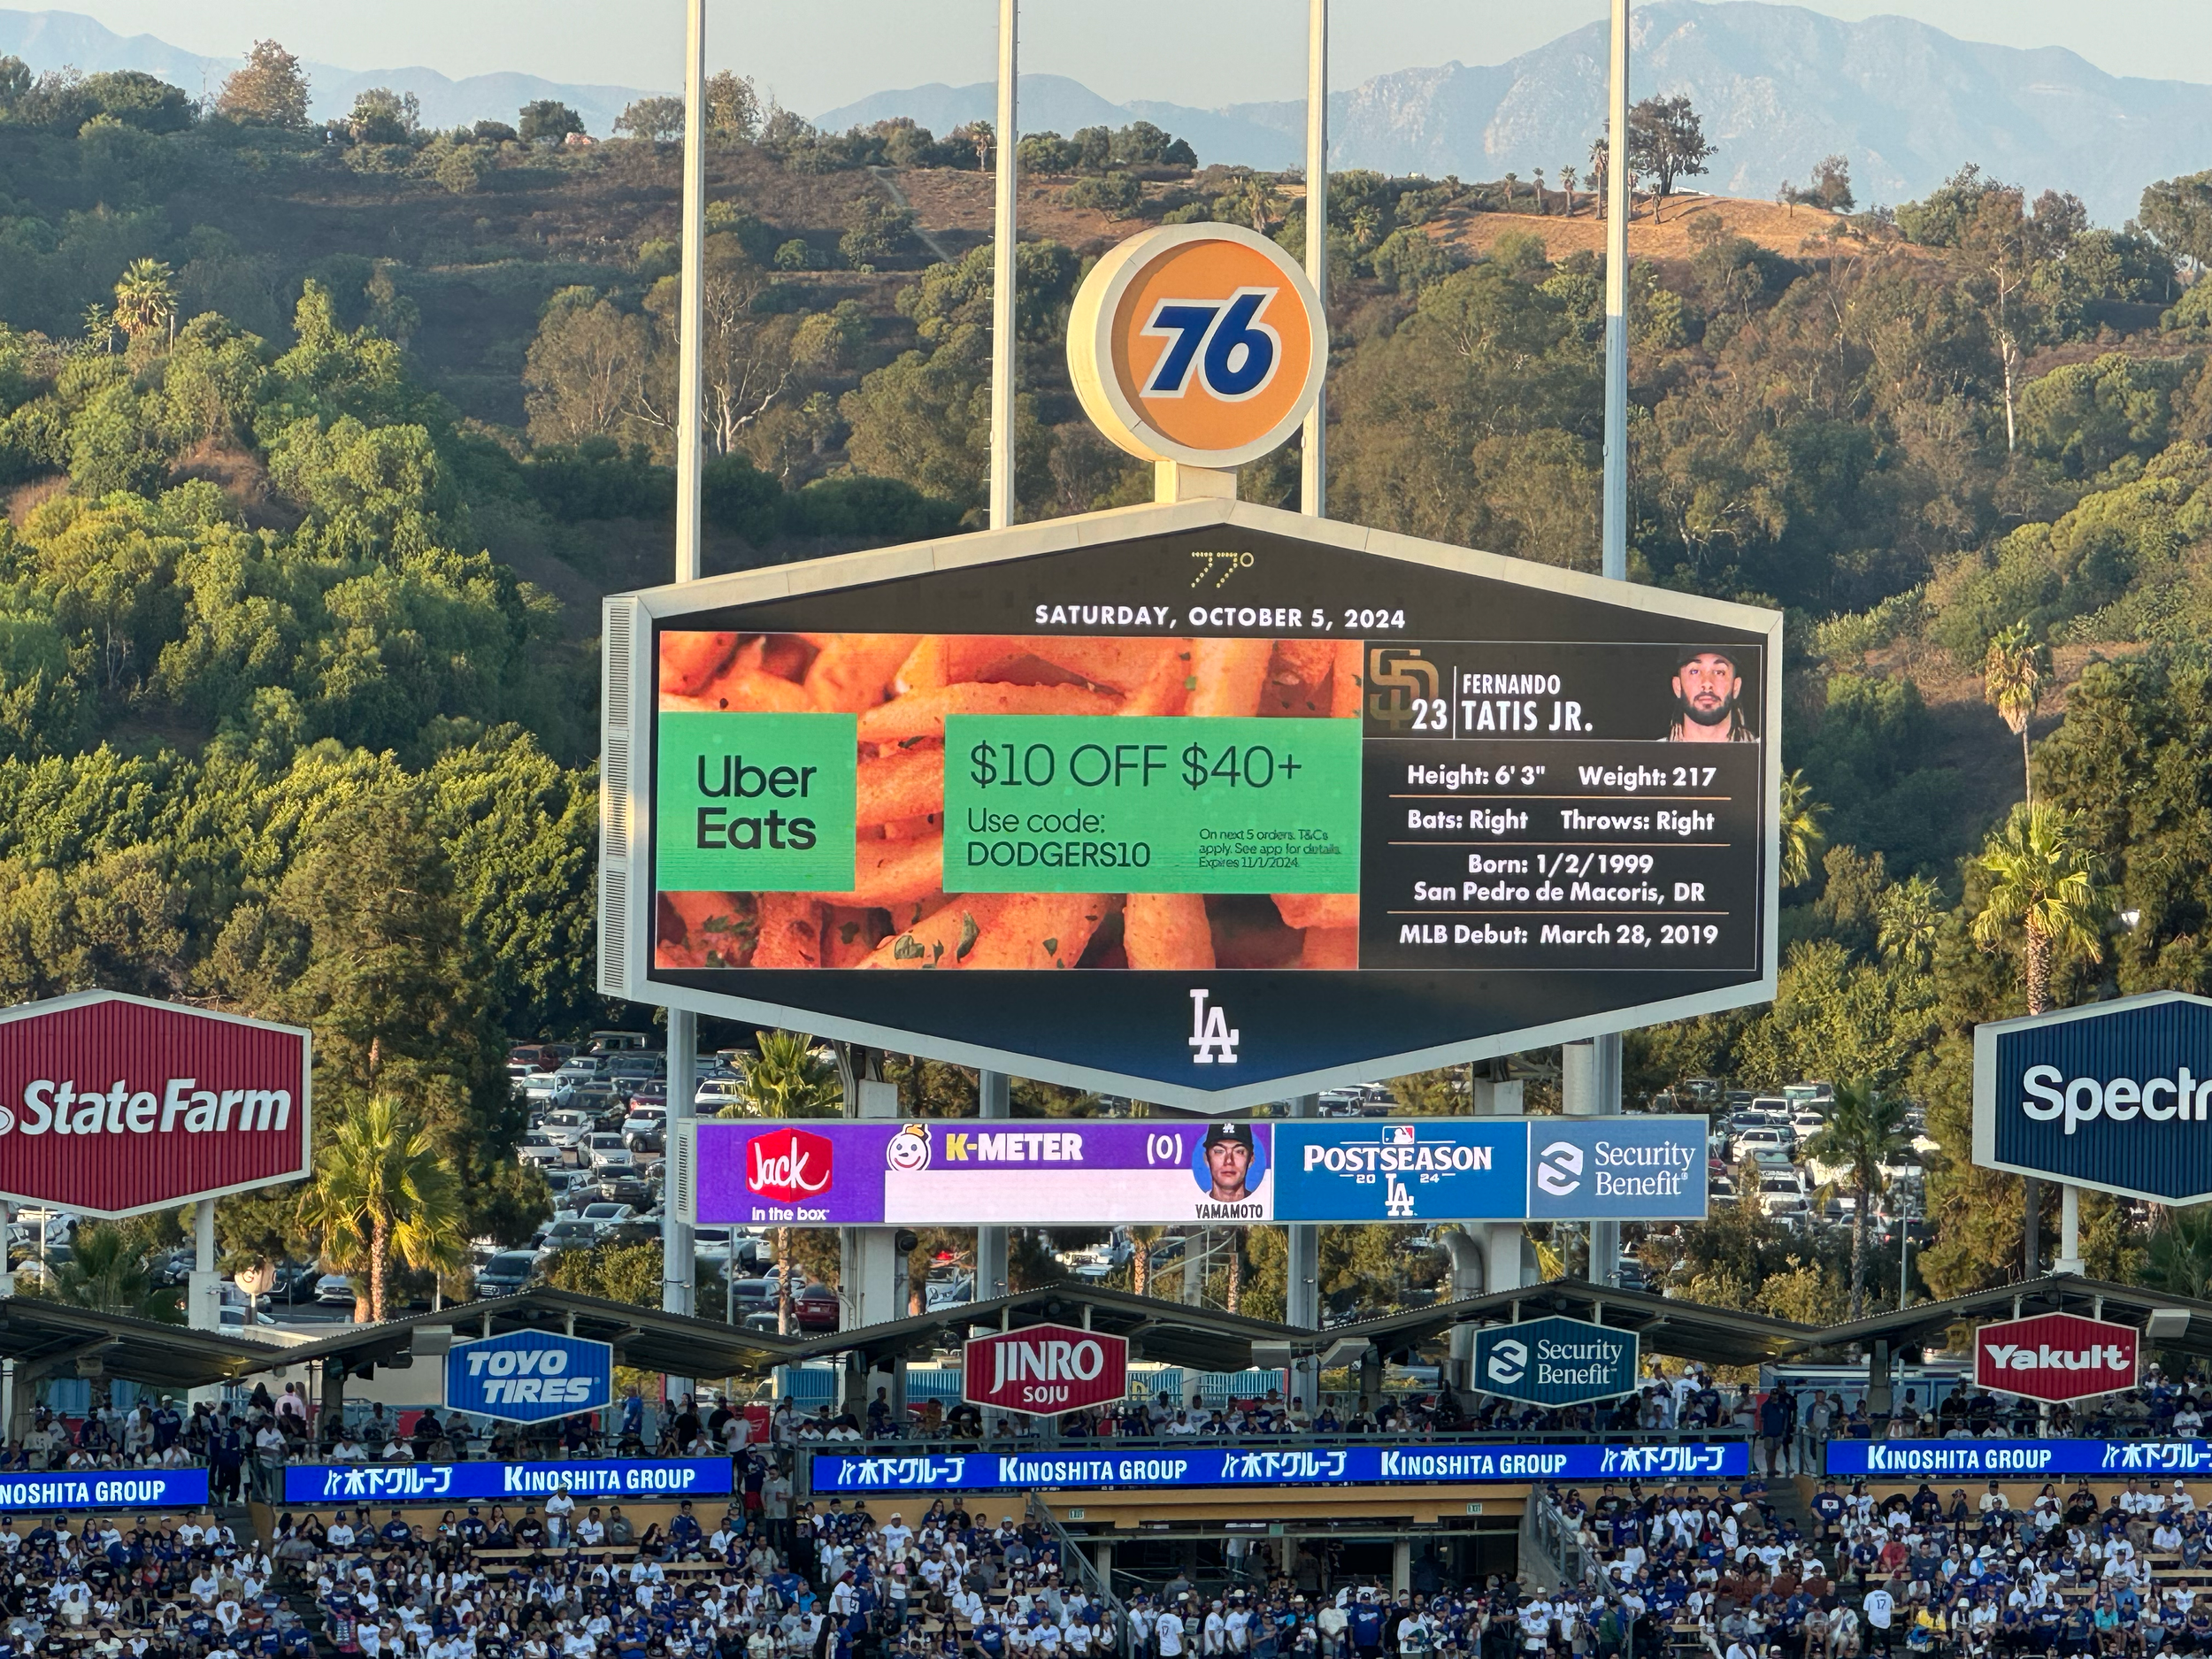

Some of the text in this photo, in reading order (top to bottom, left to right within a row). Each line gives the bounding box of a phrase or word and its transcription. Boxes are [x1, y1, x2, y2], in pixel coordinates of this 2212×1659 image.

[1140, 287, 1281, 402] 76
[1035, 604, 1405, 631] SATURDAY, OCTOBER 5, 2024
[1463, 673, 1561, 695] FERNANDO
[1411, 698, 1448, 730] 23
[1462, 700, 1594, 732] TATIS JR.
[696, 755, 817, 799] Uber
[970, 740, 1302, 791] $10 OFF $40+
[1408, 765, 1546, 790] Height: 6' 3"
[1578, 765, 1717, 791] Weight: 217
[695, 807, 817, 850] Eats
[967, 808, 1106, 833] Use code:
[1408, 808, 1529, 834] Bats: Right
[1561, 809, 1715, 835] Throws: Right
[1199, 828, 1217, 841] On
[1219, 829, 1245, 840] next
[1246, 829, 1255, 840] 5
[1298, 828, 1329, 841] T&Cs
[967, 841, 1150, 867] DODGERS10
[1198, 843, 1233, 856] apply.
[1234, 842, 1257, 854] See
[1259, 845, 1283, 856] app
[1286, 843, 1302, 855] for
[1198, 856, 1240, 871] Expires
[1468, 854, 1654, 878] Born: 1/2/1999
[1414, 881, 1706, 905] San Pedro de Macoris, DR
[1399, 925, 1718, 947] MLB Debut: March 28, 2019
[1188, 988, 1239, 1064] LA
[946, 1133, 1083, 1162] K-METER
[1147, 1133, 1183, 1164] (0)
[1303, 1144, 1493, 1171] POSTSEASON
[1594, 1141, 1696, 1171] Security
[749, 1136, 830, 1192] Jack
[1356, 1173, 1440, 1184] 20 24
[1385, 1173, 1415, 1217] LA
[768, 1206, 794, 1220] the
[797, 1206, 827, 1220] box
[1194, 1203, 1263, 1219] YAMAMOTO
[466, 1349, 568, 1376] TOYO
[1537, 1339, 1623, 1364] Security
[1984, 1344, 2130, 1371] Yakult
[989, 1340, 1104, 1394] JINRO
[482, 1377, 593, 1404] TIRES
[1023, 1385, 1069, 1405] SOJU
[1240, 1450, 1348, 1478] 木下グループ
[1381, 1450, 1567, 1476] KINOSHITA GROUP
[1620, 1446, 1725, 1472] 木下グループ
[1867, 1445, 2052, 1469] KINOSHITA GROUP
[2122, 1443, 2212, 1468] 木下グルー
[344, 1467, 453, 1494] 木下グループ
[504, 1465, 695, 1492] KINOSHITA GROUP
[857, 1457, 965, 1485] 木下グループ
[999, 1456, 1187, 1483] KINOSHITA GROUP
[96, 1480, 165, 1502] GROUP
